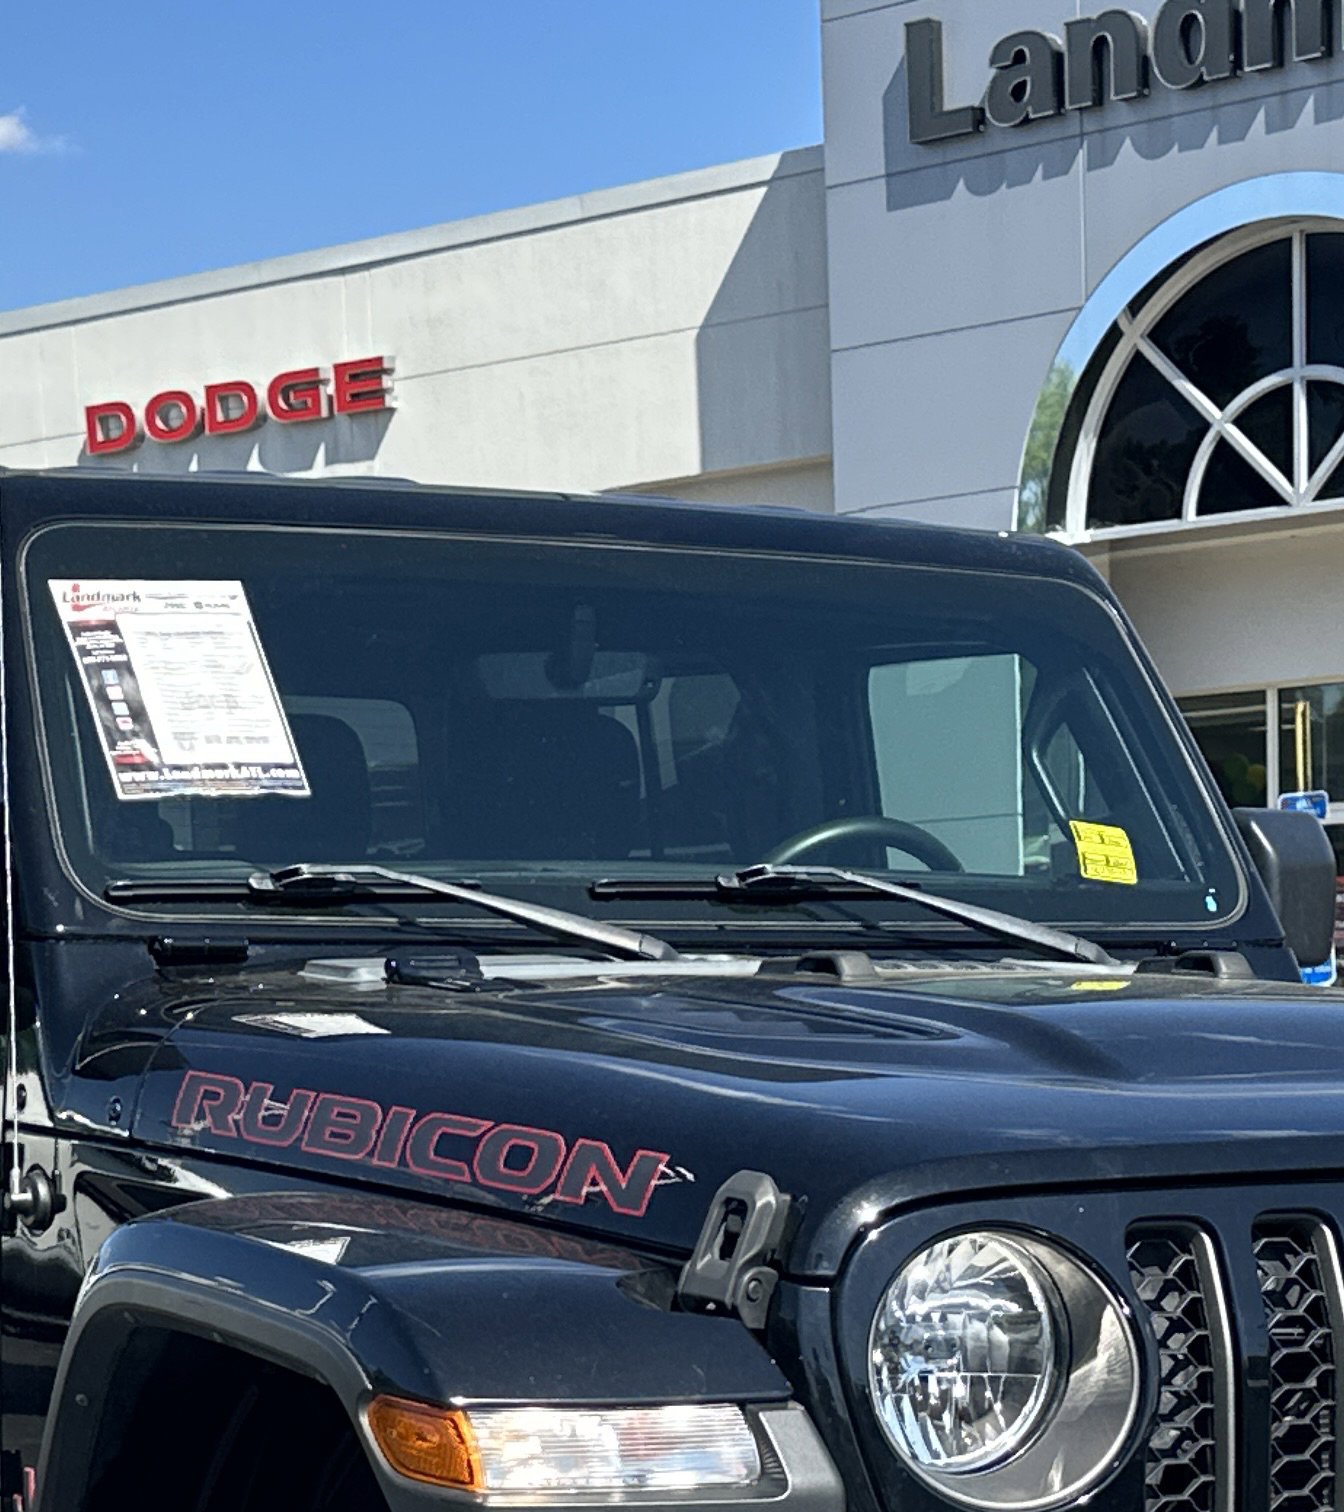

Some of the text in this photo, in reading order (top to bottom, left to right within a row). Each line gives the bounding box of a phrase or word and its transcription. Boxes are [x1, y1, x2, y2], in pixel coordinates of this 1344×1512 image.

[83, 355, 395, 456] DODGE
[62, 590, 142, 603] Landmark
[171, 1070, 670, 1217] RUBICON
